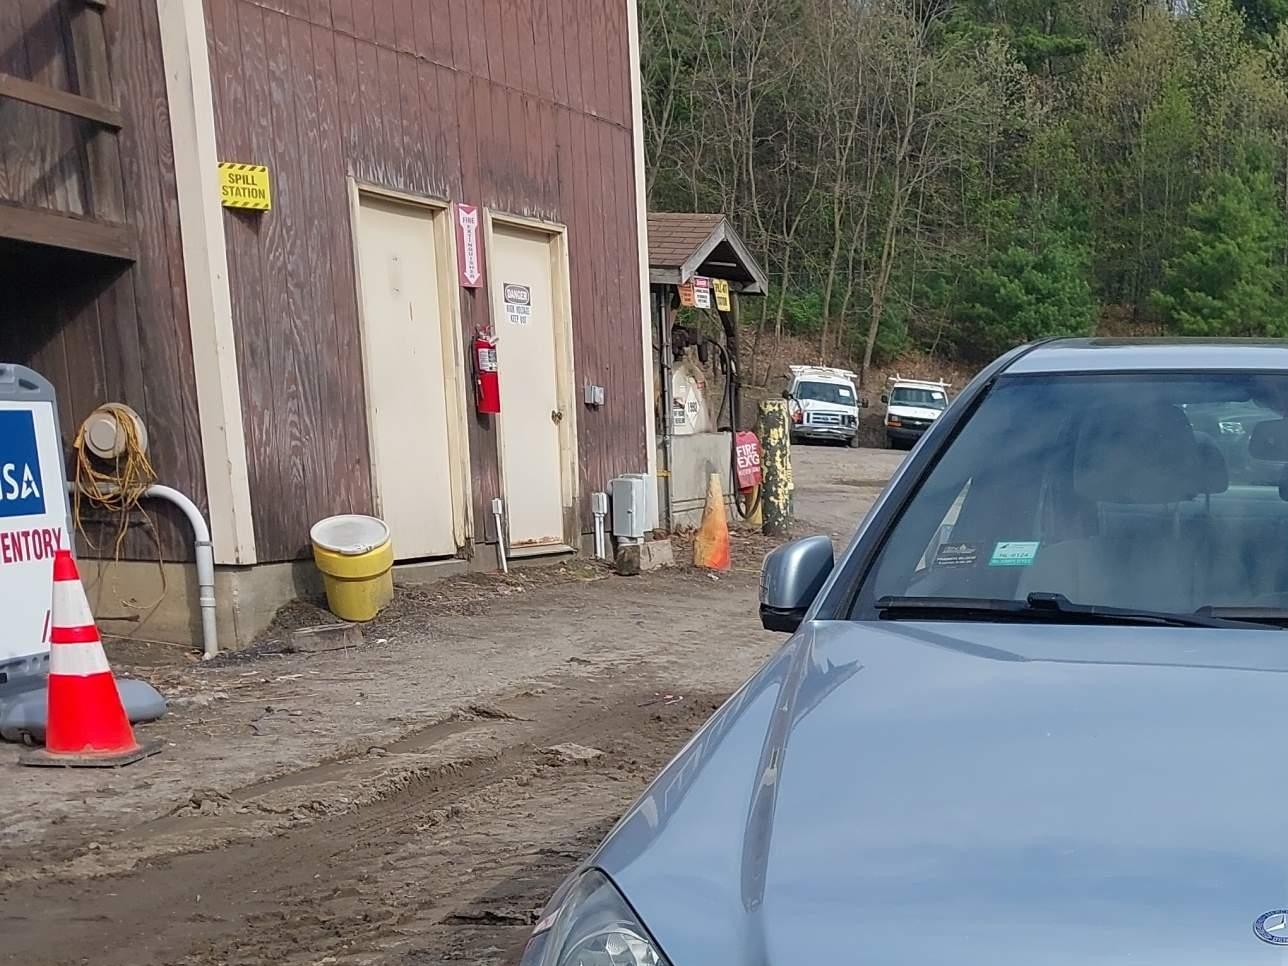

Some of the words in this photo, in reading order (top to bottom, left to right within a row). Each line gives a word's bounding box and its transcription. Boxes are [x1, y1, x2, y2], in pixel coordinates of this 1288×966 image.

[228, 172, 257, 186] SPILL
[222, 185, 266, 200] STATION
[462, 216, 475, 224] FIRE
[506, 288, 528, 301] DANGER
[736, 443, 757, 457] FIRE
